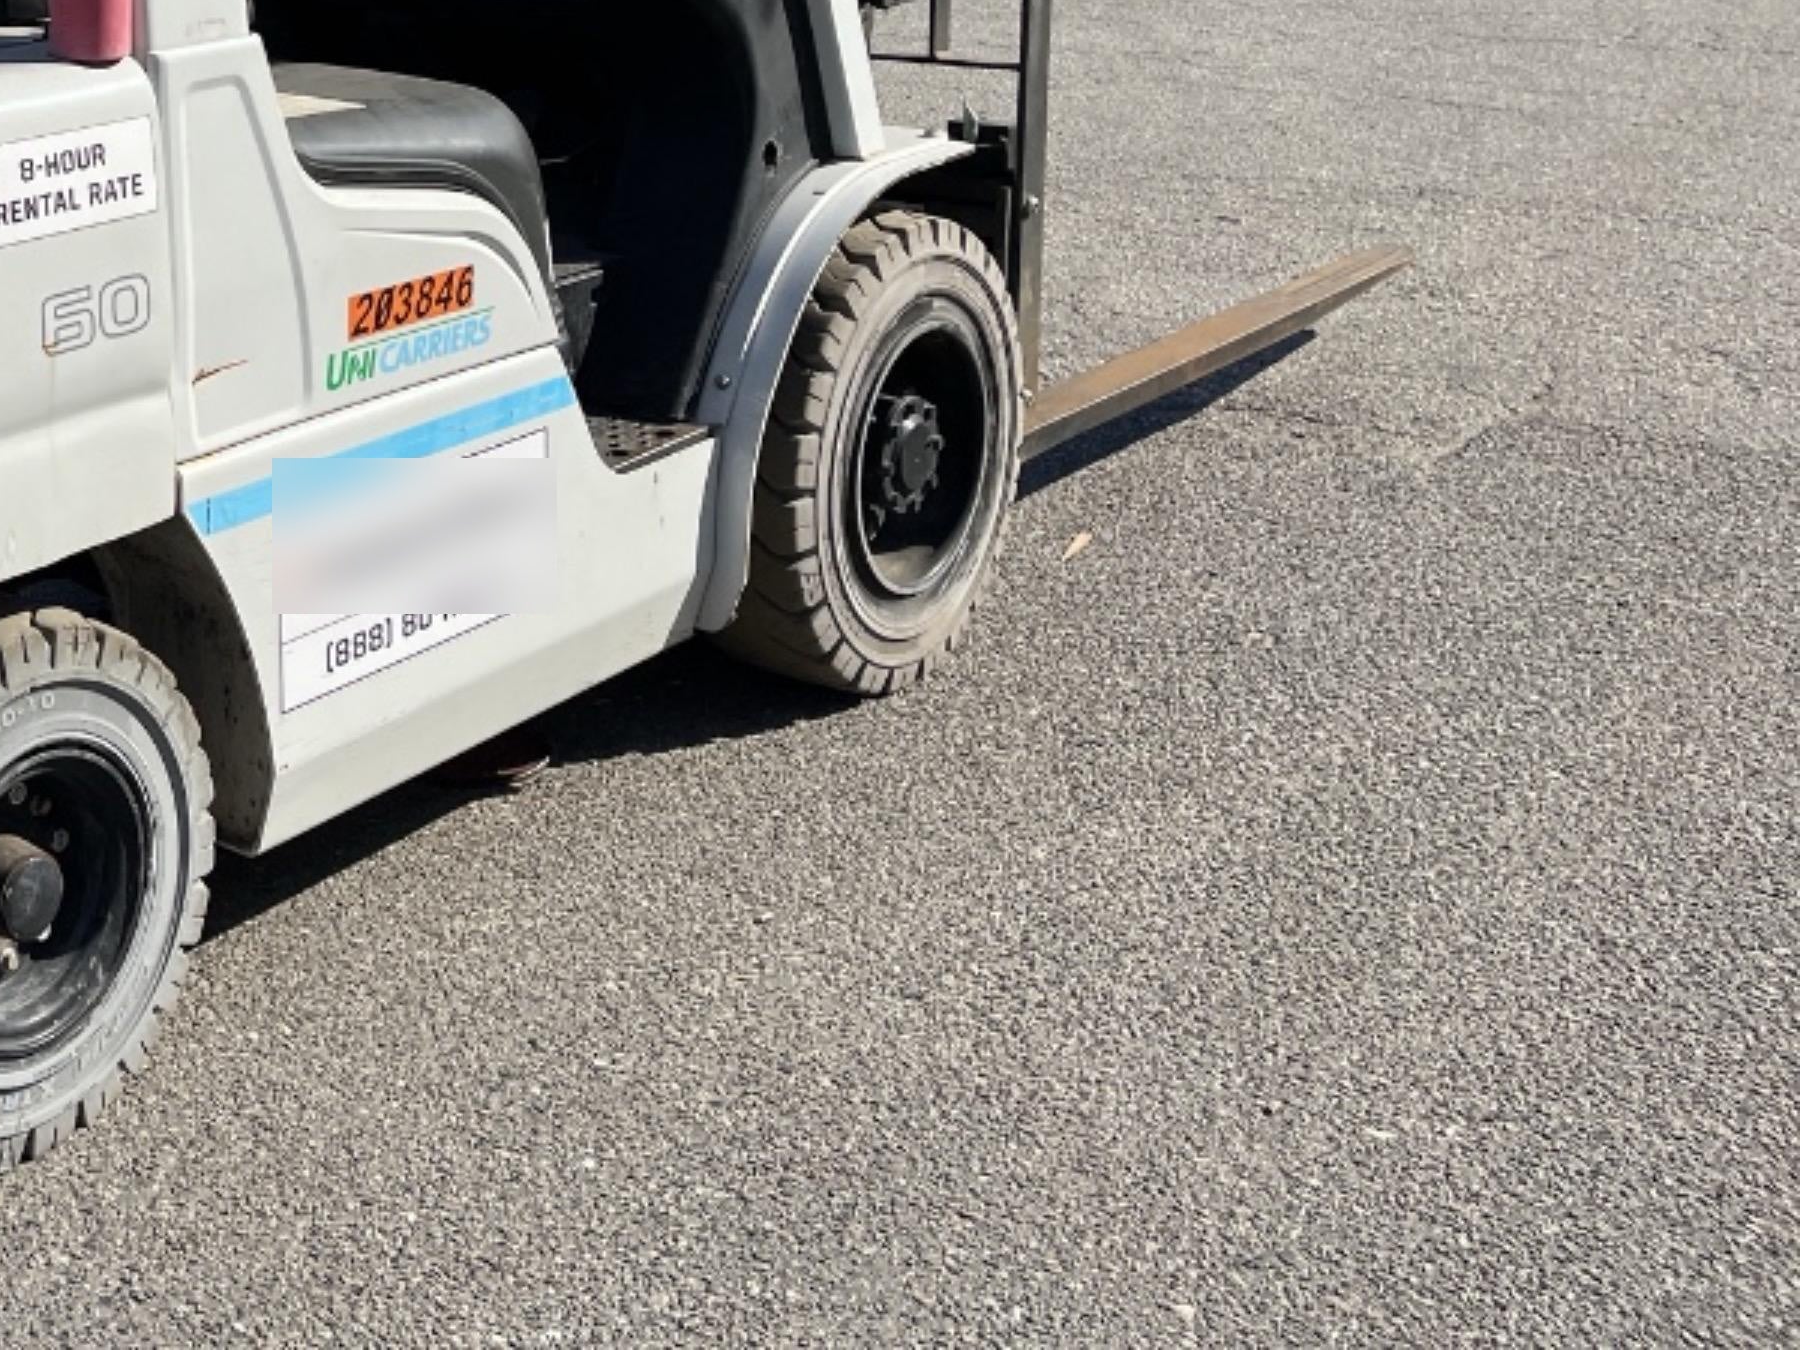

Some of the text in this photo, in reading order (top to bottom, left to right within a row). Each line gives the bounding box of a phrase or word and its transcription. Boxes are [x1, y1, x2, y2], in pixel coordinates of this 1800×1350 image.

[18, 143, 106, 183] 8-HOUR
[89, 173, 144, 207] RATE
[41, 272, 151, 358] 60
[349, 264, 475, 338] 203846
[326, 617, 393, 673] (888)
